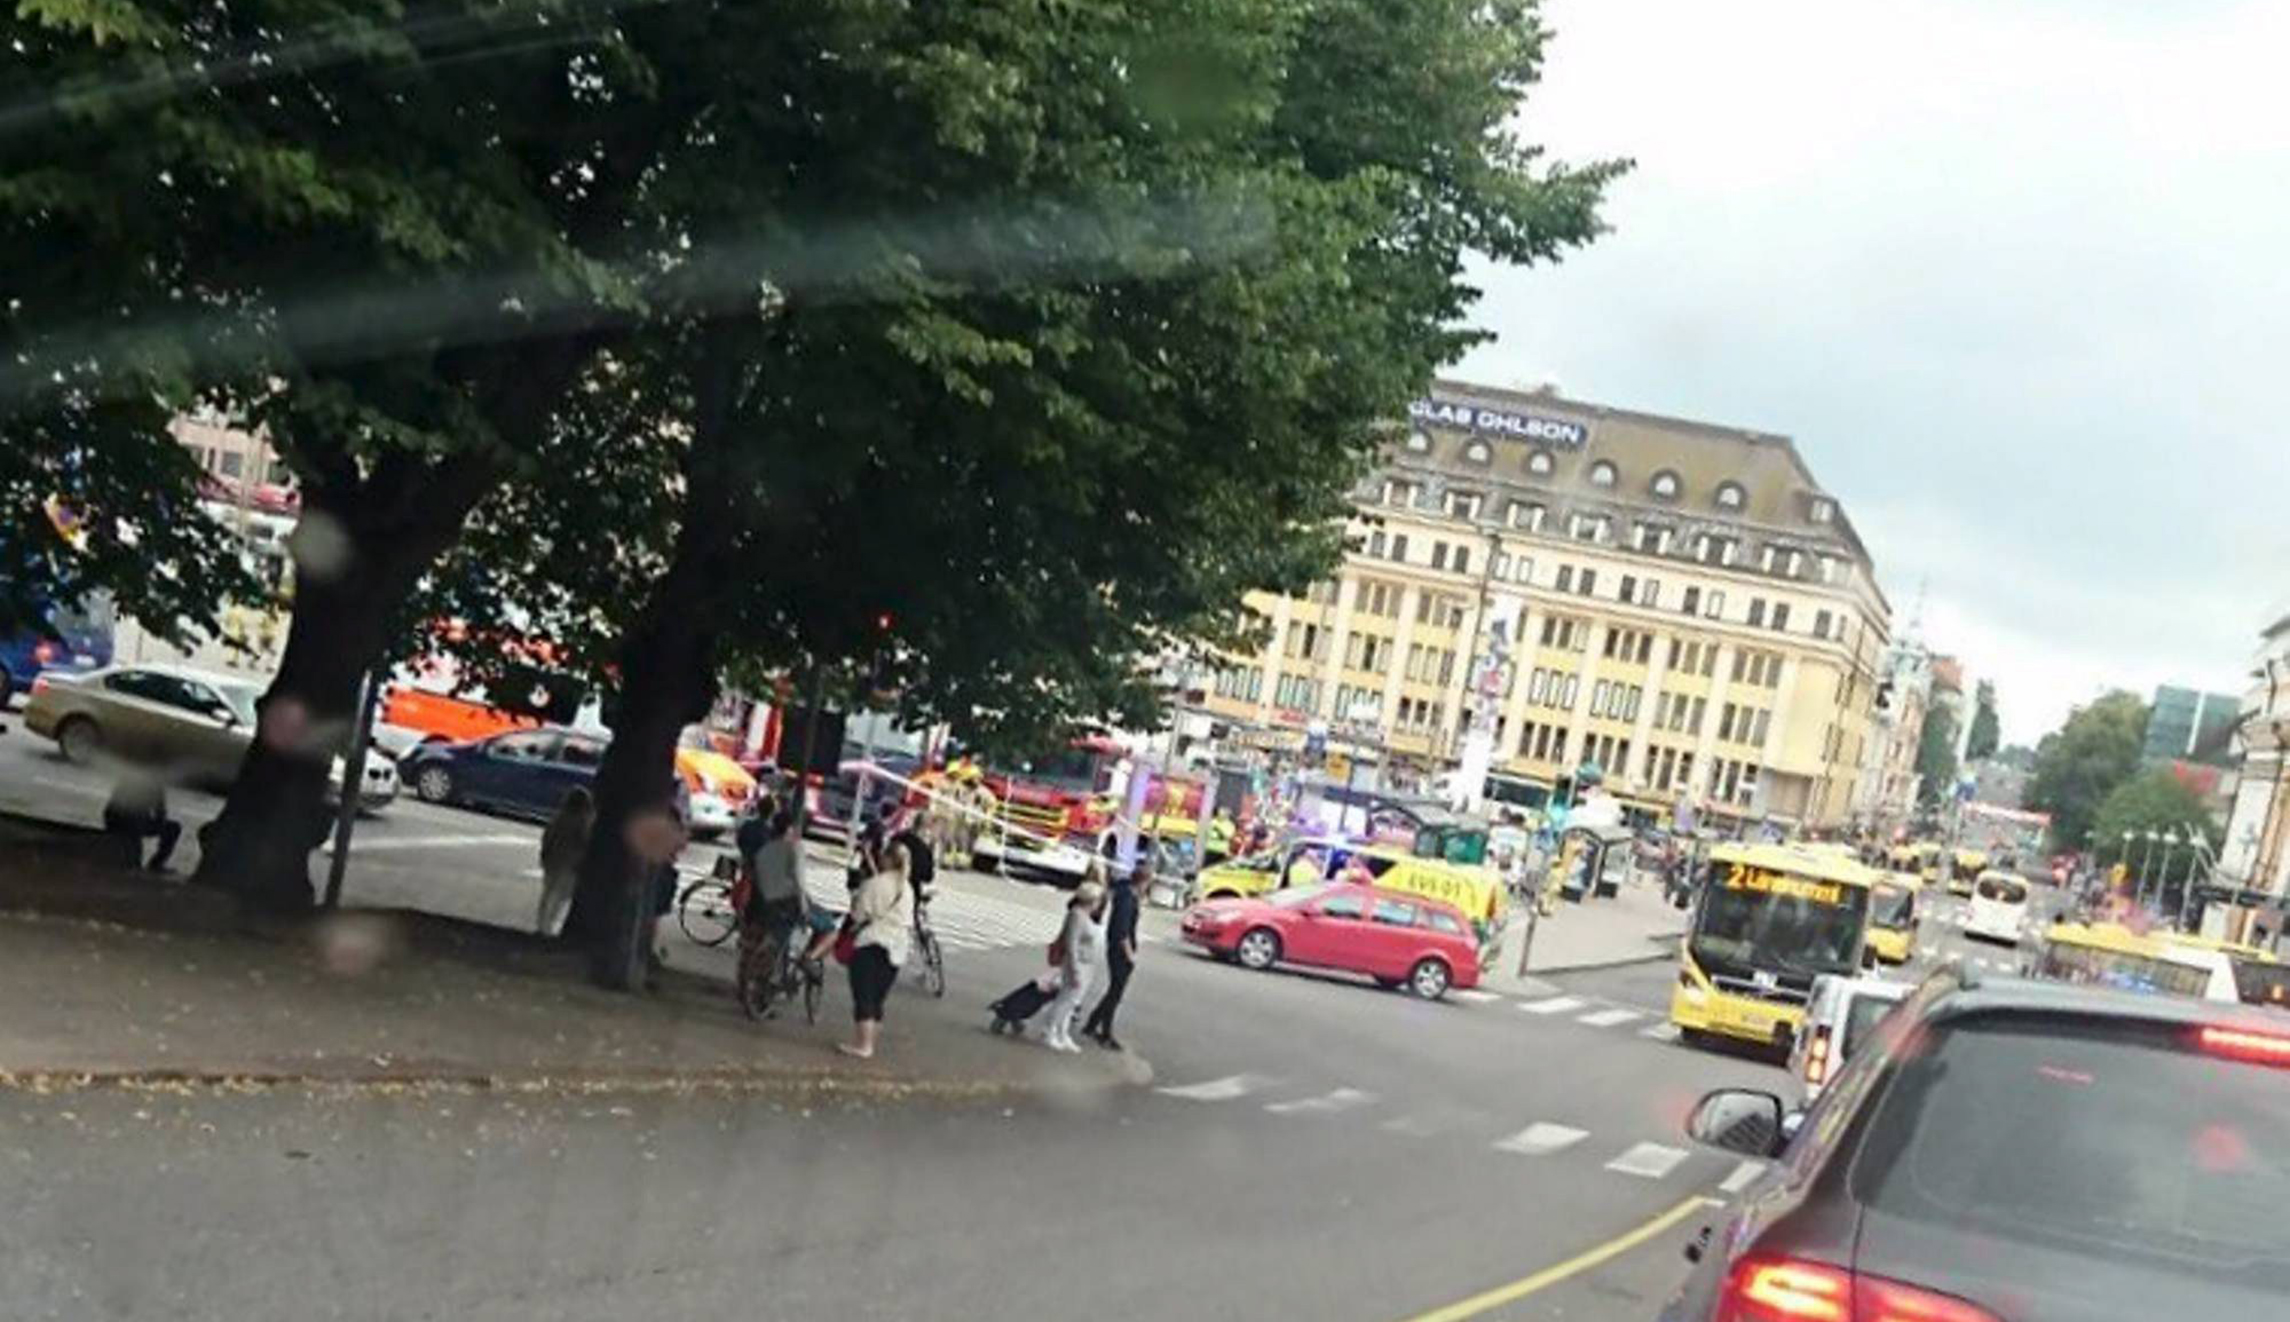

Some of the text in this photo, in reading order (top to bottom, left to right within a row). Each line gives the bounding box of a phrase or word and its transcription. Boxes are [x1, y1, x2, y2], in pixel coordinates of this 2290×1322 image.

[1408, 399, 1580, 443] CLAS OHLSON
[1728, 864, 1746, 890] 2
